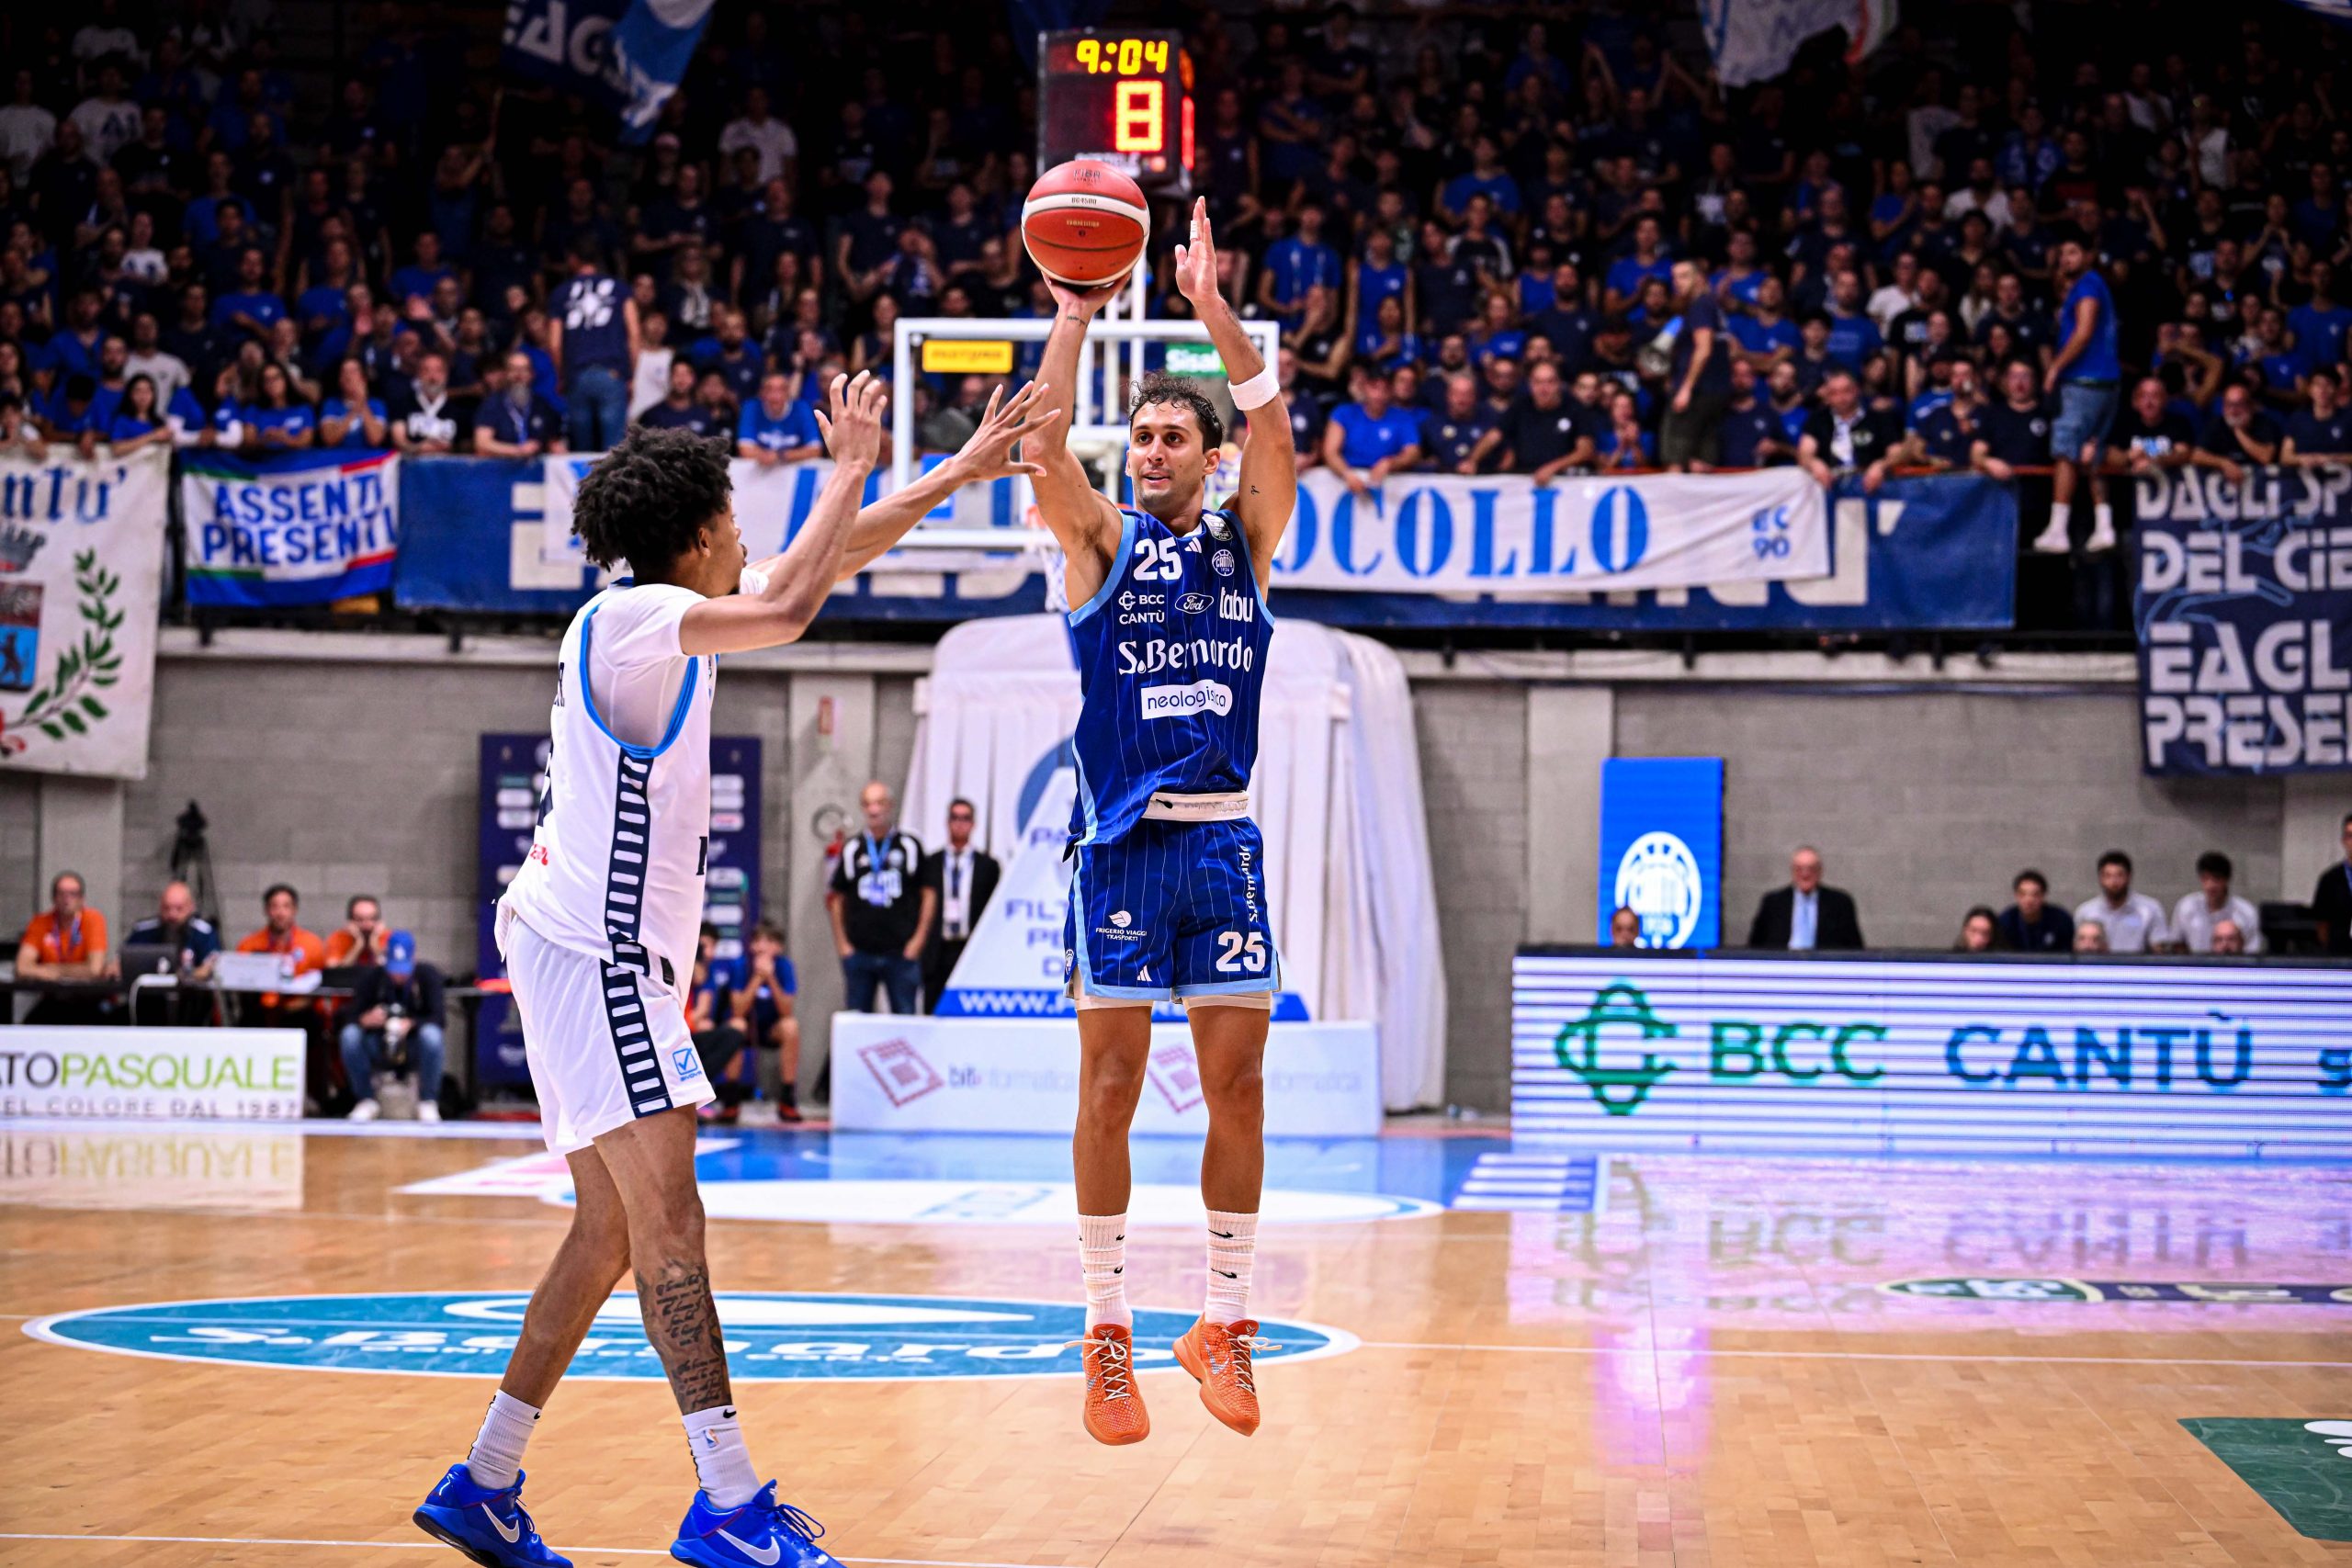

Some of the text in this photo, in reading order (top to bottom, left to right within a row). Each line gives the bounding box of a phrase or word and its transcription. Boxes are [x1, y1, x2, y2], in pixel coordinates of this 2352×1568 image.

[1076, 39, 1169, 74] 9:04
[1115, 80, 1163, 152] 8
[214, 472, 384, 525] ASSENTI
[2293, 463, 2352, 518] SP
[201, 505, 399, 565] PRESENTI
[1133, 536, 1183, 581] 25
[2141, 530, 2258, 593] DEL
[1119, 610, 1165, 625] CANTÙ
[1139, 594, 1165, 605] BCC
[1182, 597, 1204, 611] Ford
[1219, 587, 1254, 622] tabu
[1118, 636, 1253, 675] S.Bernardo
[2144, 694, 2352, 767] PRESE
[1095, 927, 1148, 937] FRIGERIO VIAGGI
[1216, 931, 1266, 972] 25
[0, 1052, 298, 1090] TOPASQUALE
[1710, 1021, 1887, 1082] BCC
[46, 1095, 159, 1118] COLORE
[170, 1097, 222, 1119] DAL
